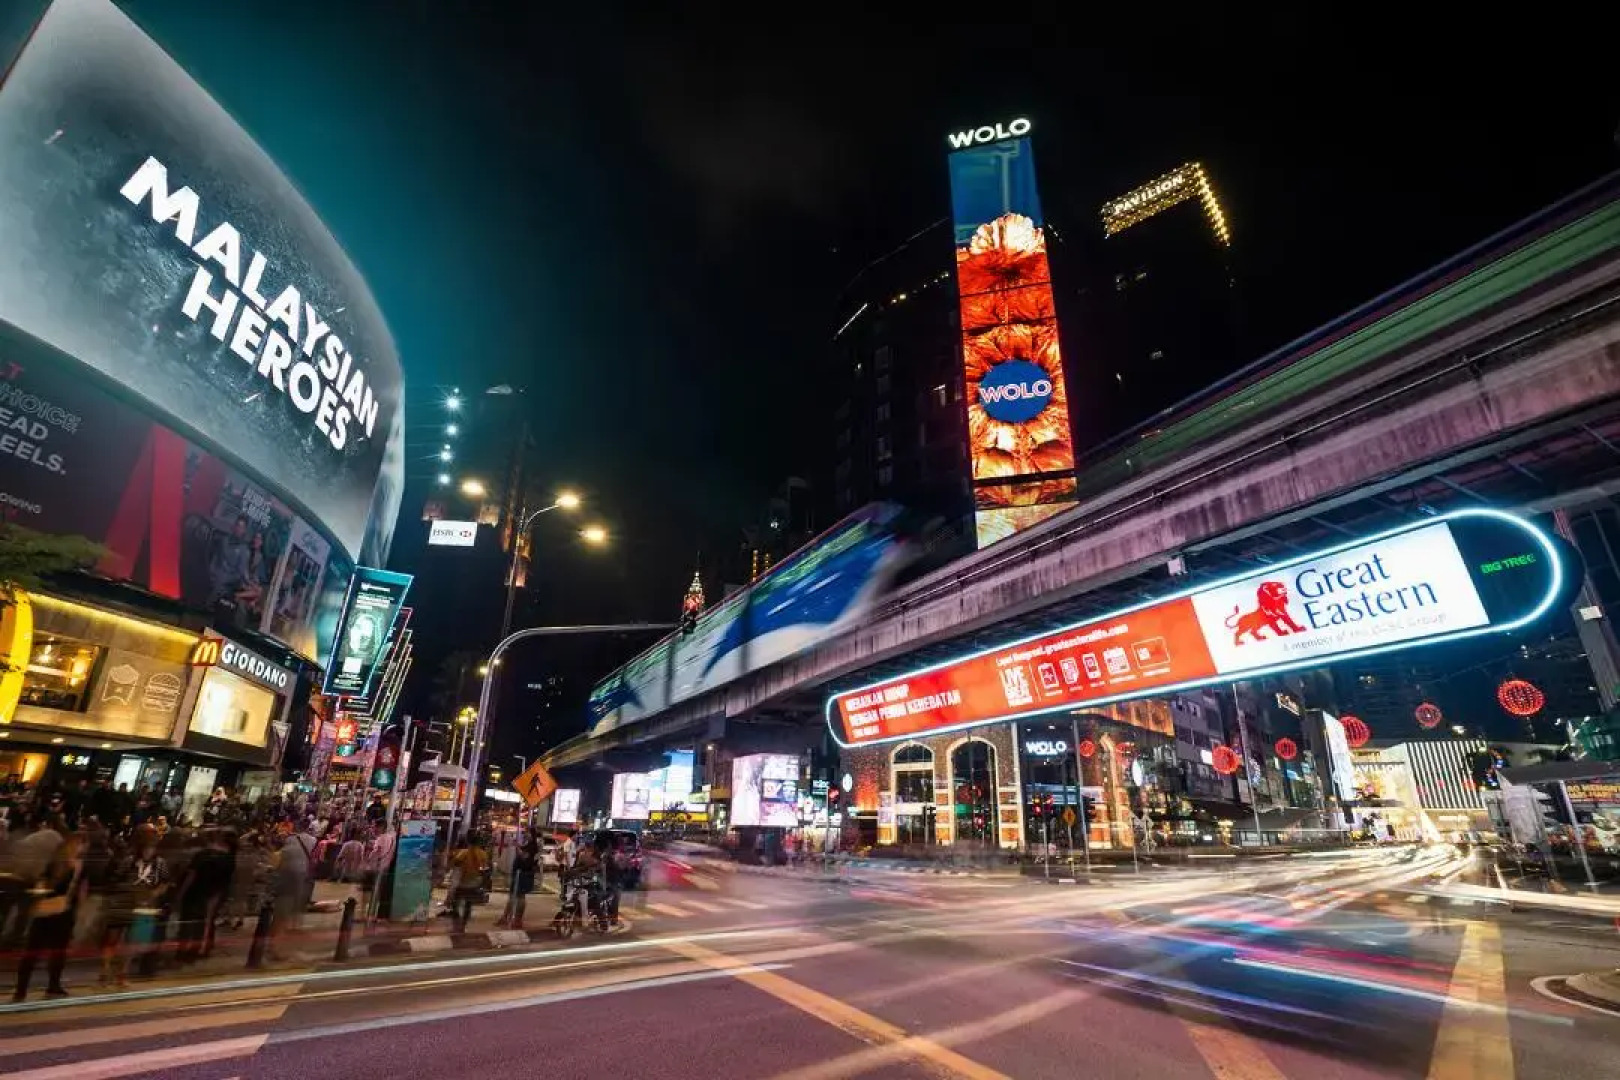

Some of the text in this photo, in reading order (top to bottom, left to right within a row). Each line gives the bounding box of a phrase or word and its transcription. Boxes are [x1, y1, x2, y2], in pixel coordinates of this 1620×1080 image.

[949, 118, 1031, 148] WOLO
[120, 156, 378, 438] MALAYSIAN
[181, 265, 351, 450] HEROES
[978, 380, 1052, 402] WOLO
[1295, 553, 1390, 598] Great
[1303, 582, 1438, 629] Eastern
[222, 643, 287, 687] GIORDANO
[1025, 740, 1067, 755] WOLO
